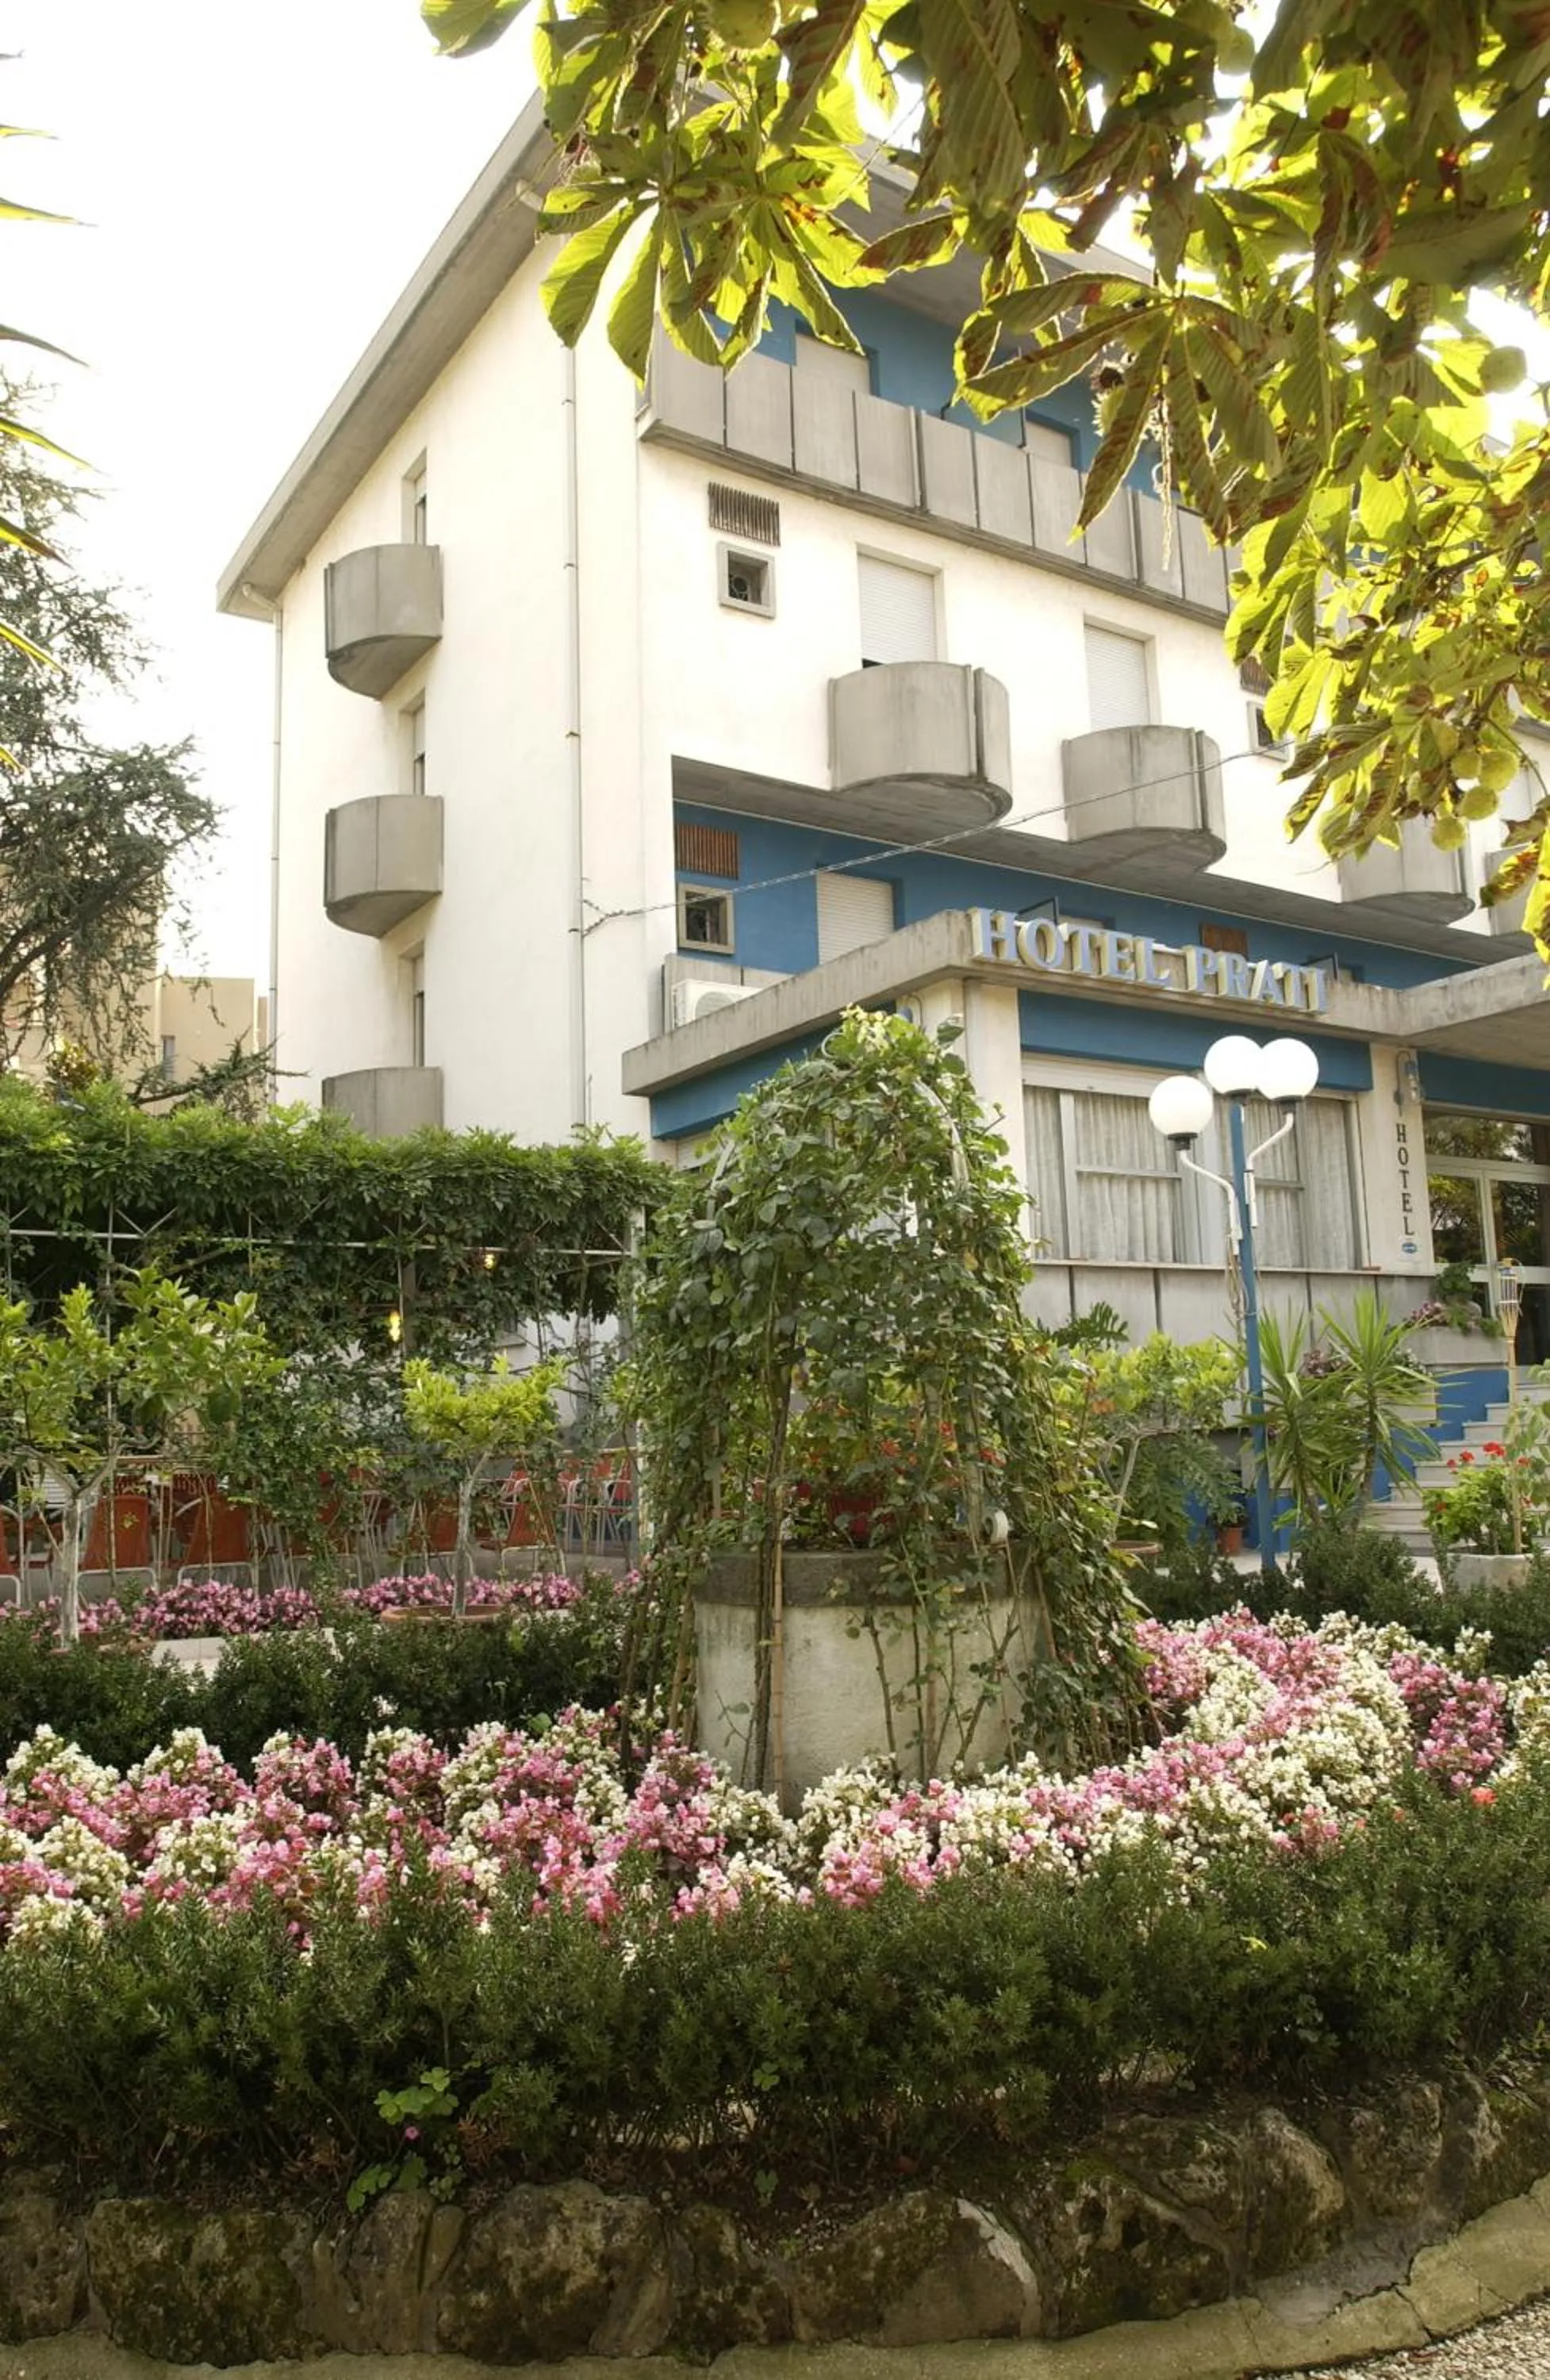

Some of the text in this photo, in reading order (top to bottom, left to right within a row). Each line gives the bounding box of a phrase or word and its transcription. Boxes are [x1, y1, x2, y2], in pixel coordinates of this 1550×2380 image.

[969, 907, 1327, 1013] HOTEL PRATI
[1396, 1123, 1414, 1236] HOTEL
